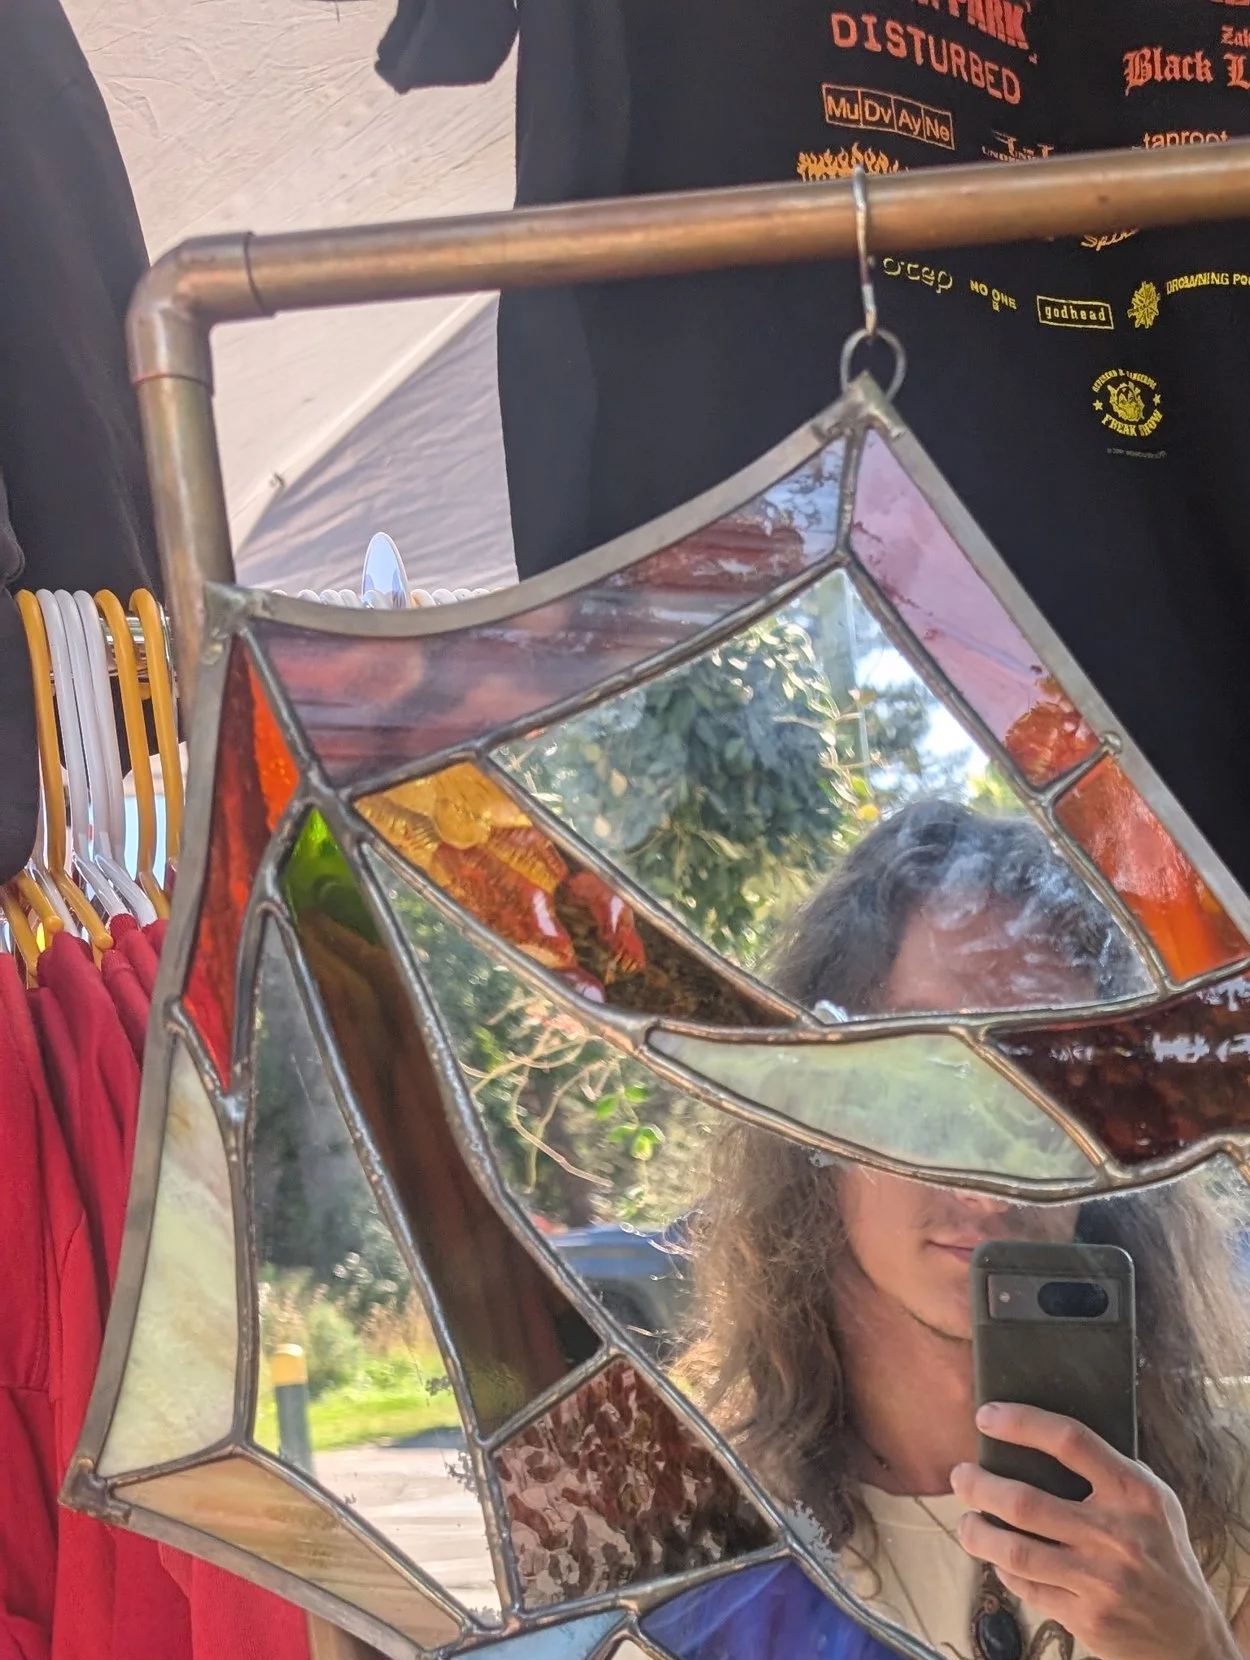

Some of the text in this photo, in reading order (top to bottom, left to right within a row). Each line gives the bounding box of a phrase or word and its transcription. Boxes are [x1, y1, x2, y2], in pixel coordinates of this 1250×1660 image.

[831, 12, 1021, 104] DISTURBED
[1123, 47, 1214, 96] Black
[970, 279, 1017, 310] NO ONE
[1166, 272, 1230, 295] DROWNING
[1044, 304, 1107, 322] godhead
[1101, 408, 1163, 437] FREAK SHOW
